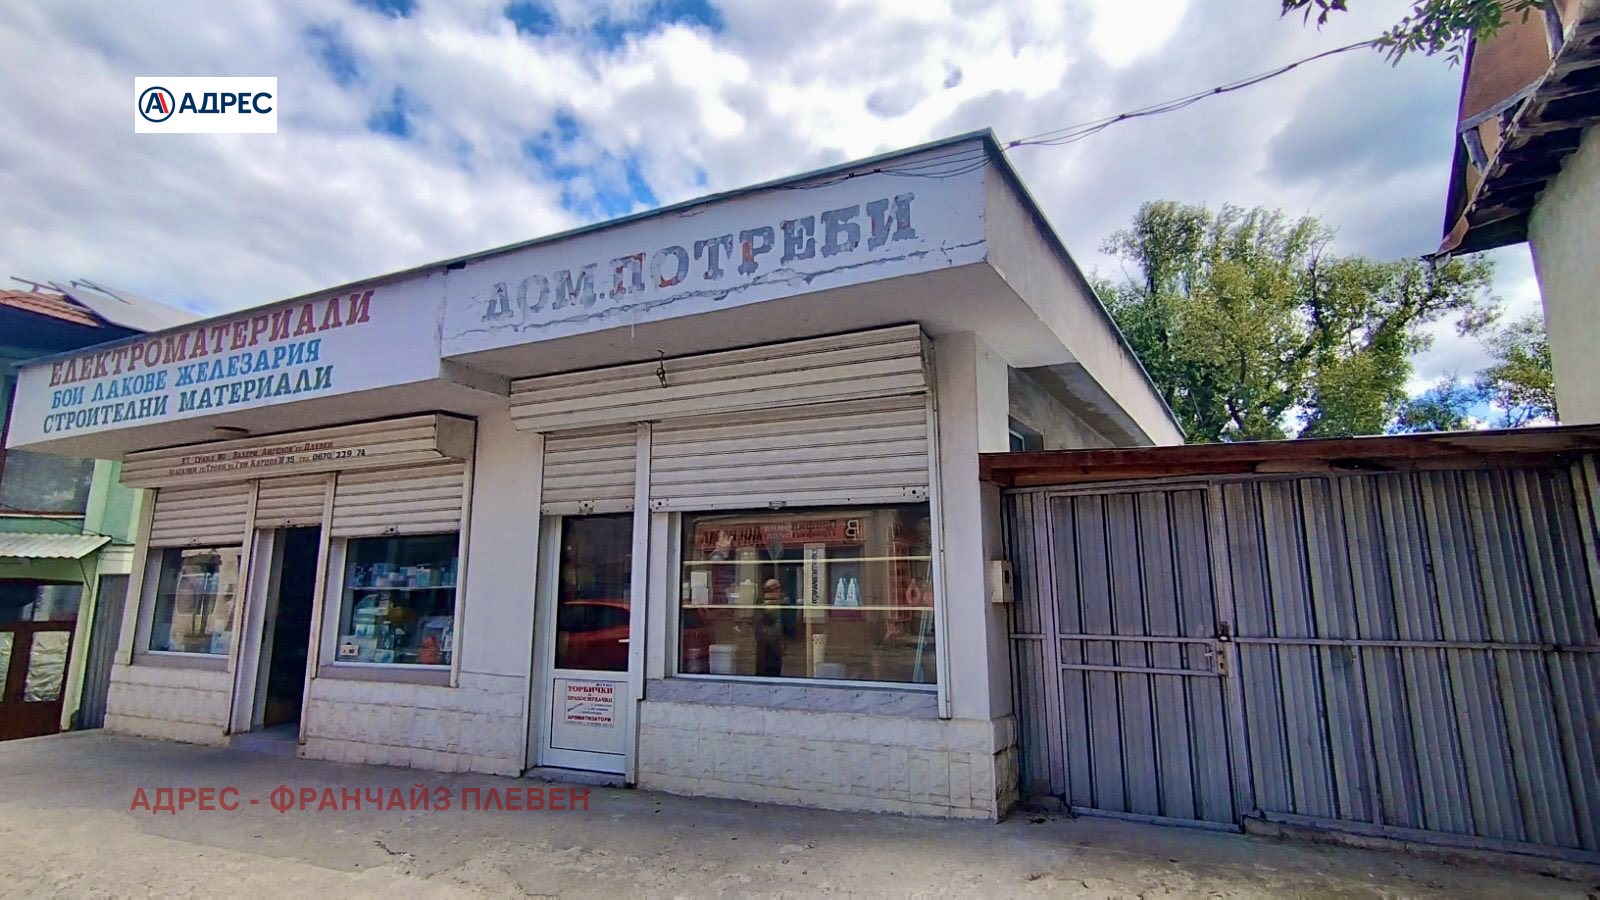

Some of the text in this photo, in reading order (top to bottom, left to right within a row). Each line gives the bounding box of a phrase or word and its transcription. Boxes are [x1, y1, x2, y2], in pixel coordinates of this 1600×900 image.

[49, 290, 375, 387] ЕЛЕКТРОМАТЕРИАЛИ
[51, 337, 323, 409] БОИ ЛАКОВЕ ЖЕЛЕЗАРИЯ
[43, 365, 334, 434] СТРОИТЕЛНИ МАТЕРИАЛИ
[336, 449, 352, 459] 229
[568, 686, 613, 694] ТОРБИЧКИ
